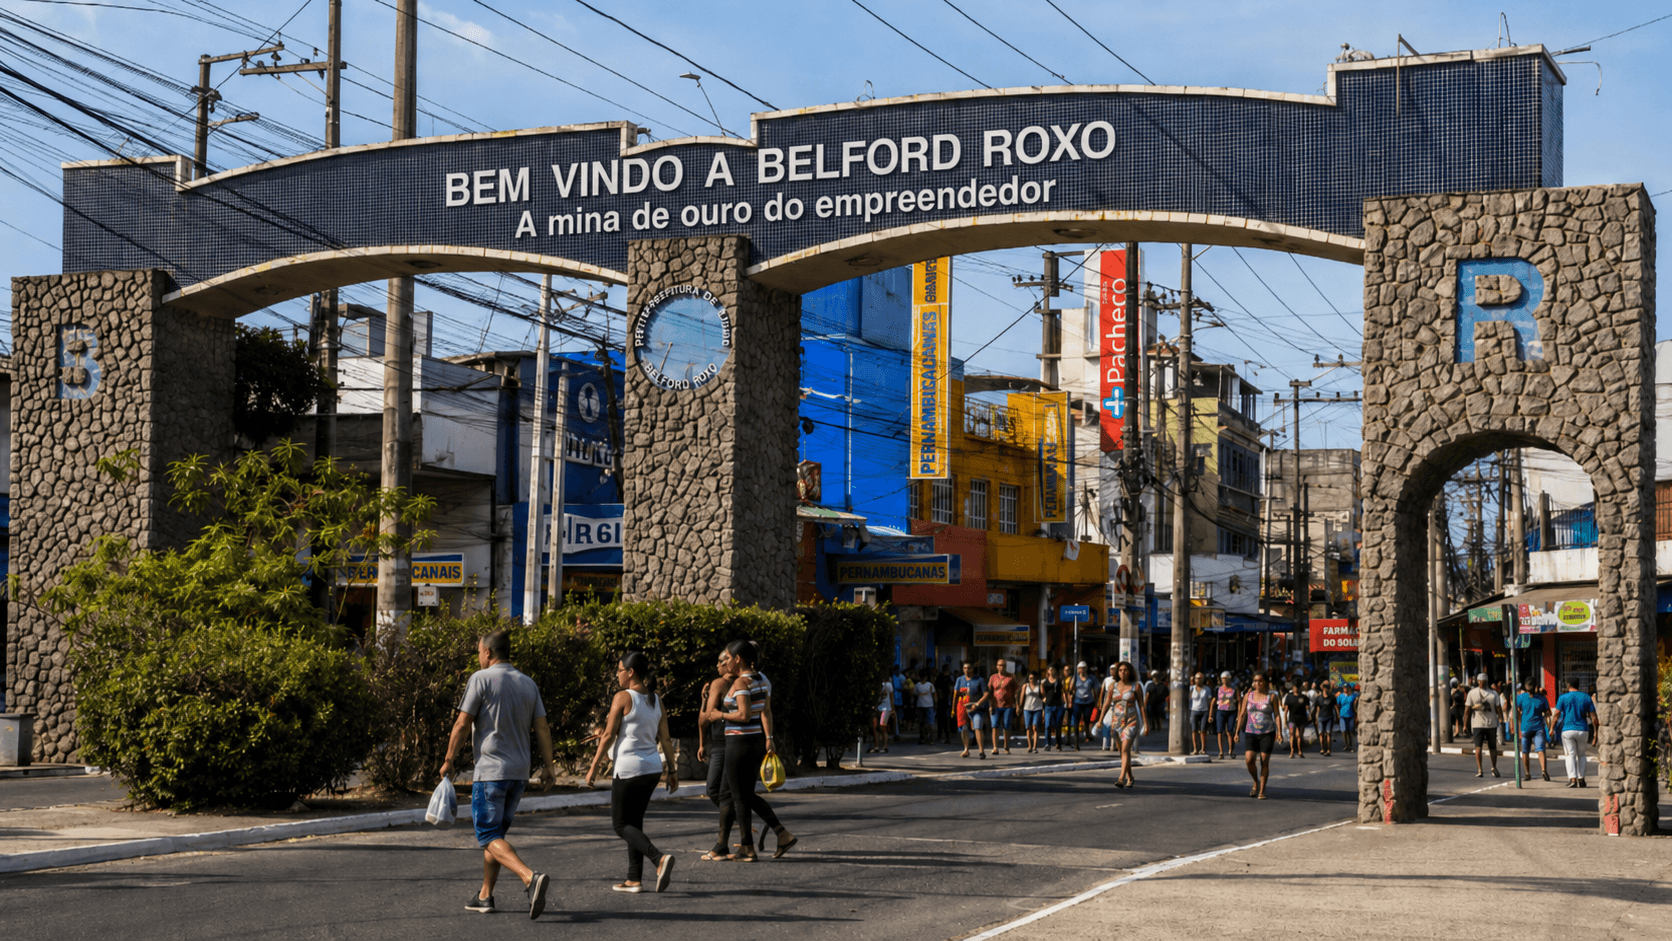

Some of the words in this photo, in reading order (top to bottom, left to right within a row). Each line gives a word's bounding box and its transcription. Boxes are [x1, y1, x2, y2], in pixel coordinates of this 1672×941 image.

[445, 167, 530, 208] BEM
[552, 153, 684, 199] VINDO
[704, 151, 735, 188] A
[757, 133, 962, 184] BELFORD
[983, 120, 1117, 167] ROXO
[515, 210, 537, 238] A
[547, 202, 621, 236] mina
[632, 200, 670, 230] de
[681, 199, 752, 226] ouro
[764, 190, 804, 221] do
[815, 175, 1056, 223] empreendedor
[703, 291, 718, 306] DE
[1455, 258, 1544, 363] R
[1105, 278, 1126, 383] Pacheco
[644, 363, 690, 390] BELFORD
[840, 566, 946, 579] PERNAMBUCANAS
[1323, 638, 1336, 647] DO
